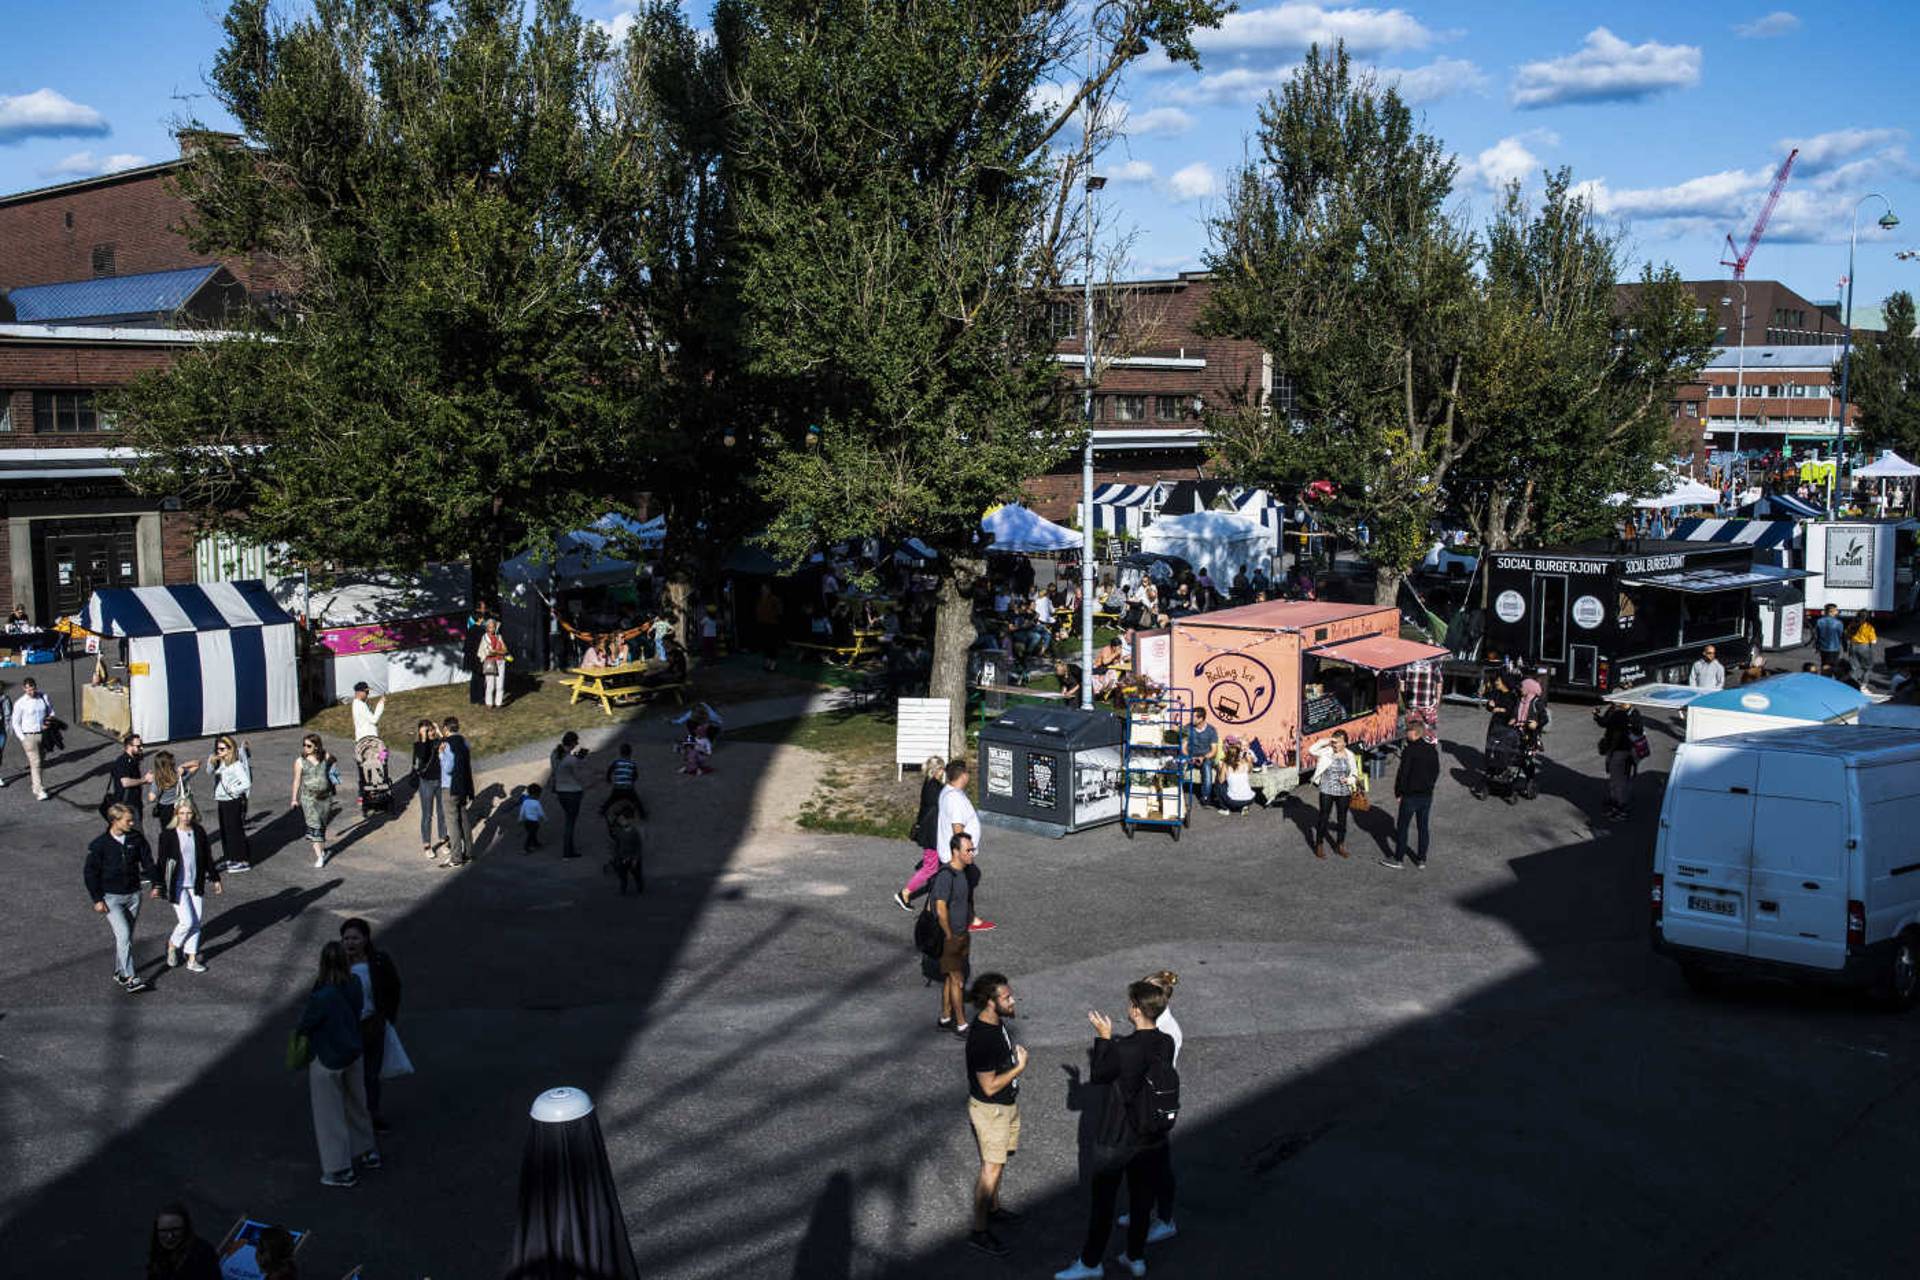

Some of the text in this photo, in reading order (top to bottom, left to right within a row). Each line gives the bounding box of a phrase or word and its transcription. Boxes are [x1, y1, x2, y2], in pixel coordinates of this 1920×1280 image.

[1497, 557, 1608, 575] SOCIAL BURGERJOINT
[1625, 555, 1686, 574] SOCIAL BURGERJOINT
[1835, 555, 1862, 566] Levant
[1205, 666, 1238, 684] Rolling
